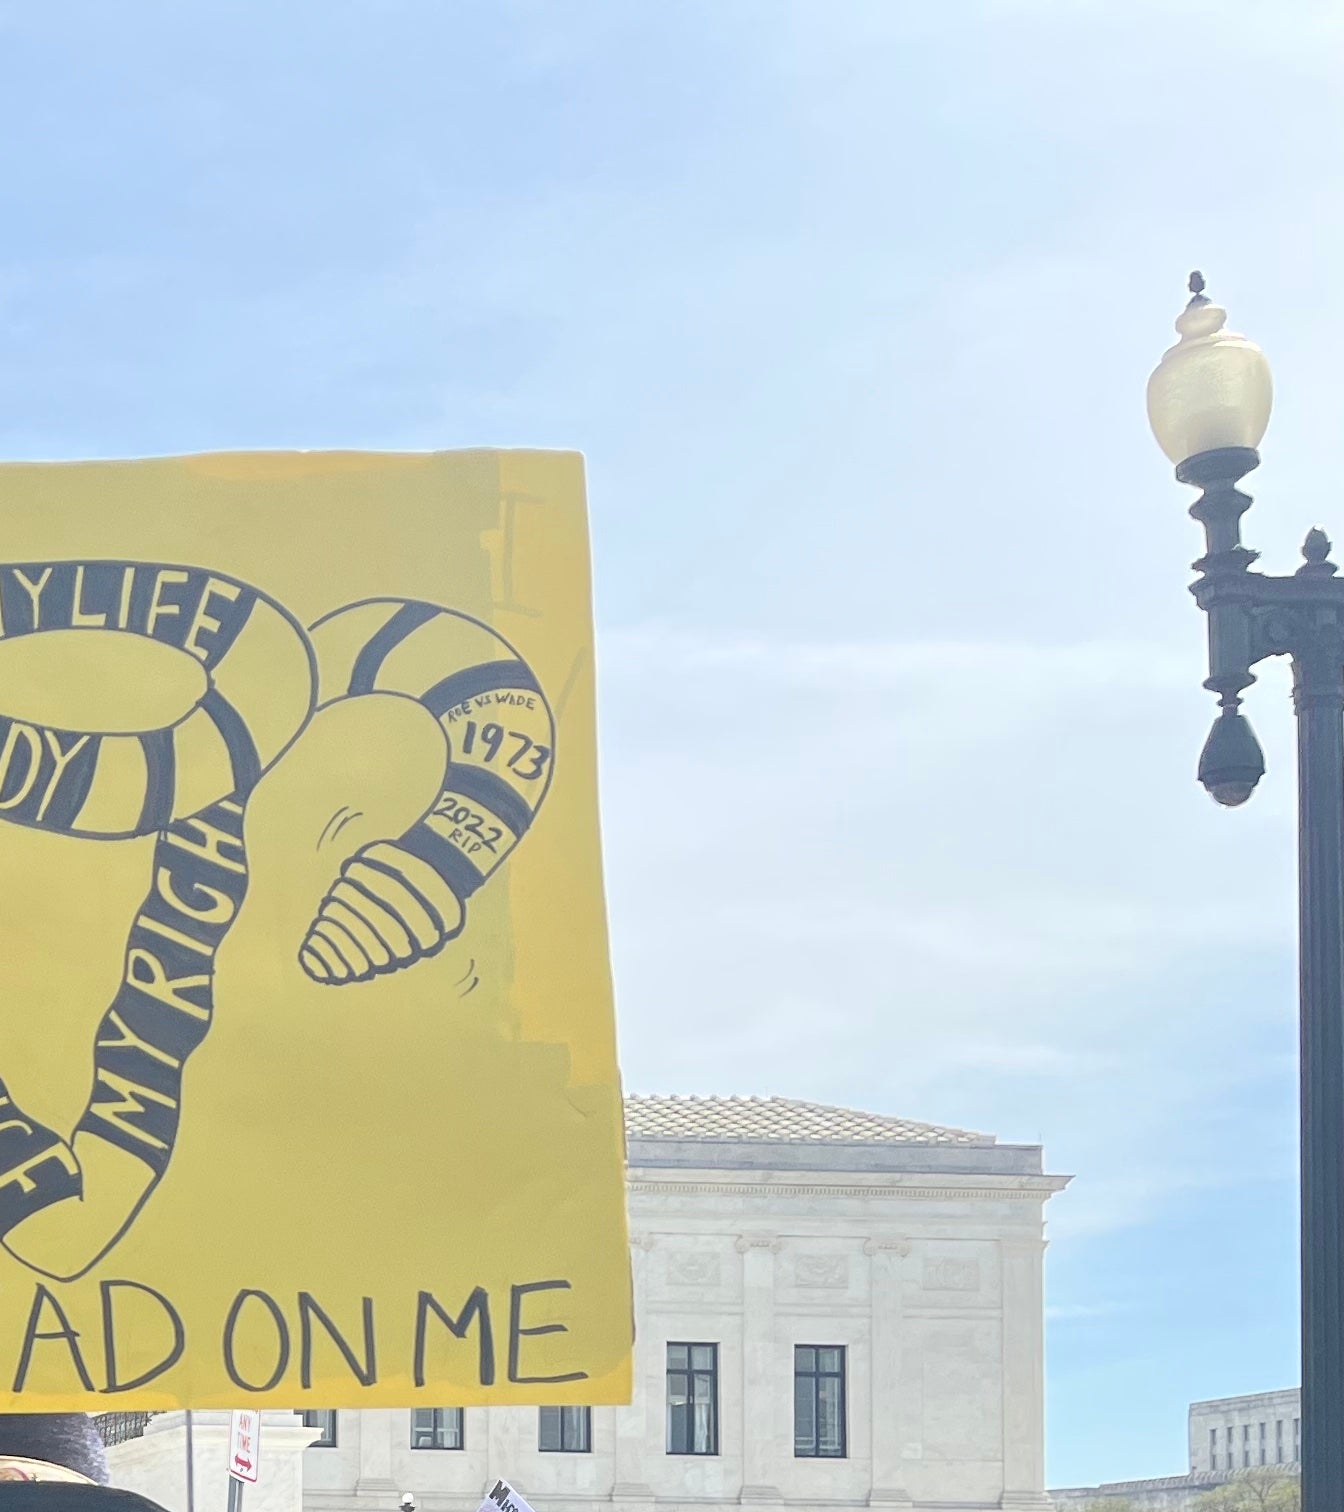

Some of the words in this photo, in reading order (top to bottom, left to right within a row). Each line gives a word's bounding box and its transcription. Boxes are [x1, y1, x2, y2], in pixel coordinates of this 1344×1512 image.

[71, 565, 240, 660] LIFE
[448, 701, 472, 723] ROE
[474, 694, 491, 708] VS
[495, 692, 536, 711] WADE
[463, 721, 551, 780] 1973
[433, 797, 503, 854] 2022
[448, 828, 481, 853] RIP
[88, 1010, 180, 1149] MY
[224, 1287, 375, 1391] ON
[412, 1279, 588, 1389] ME
